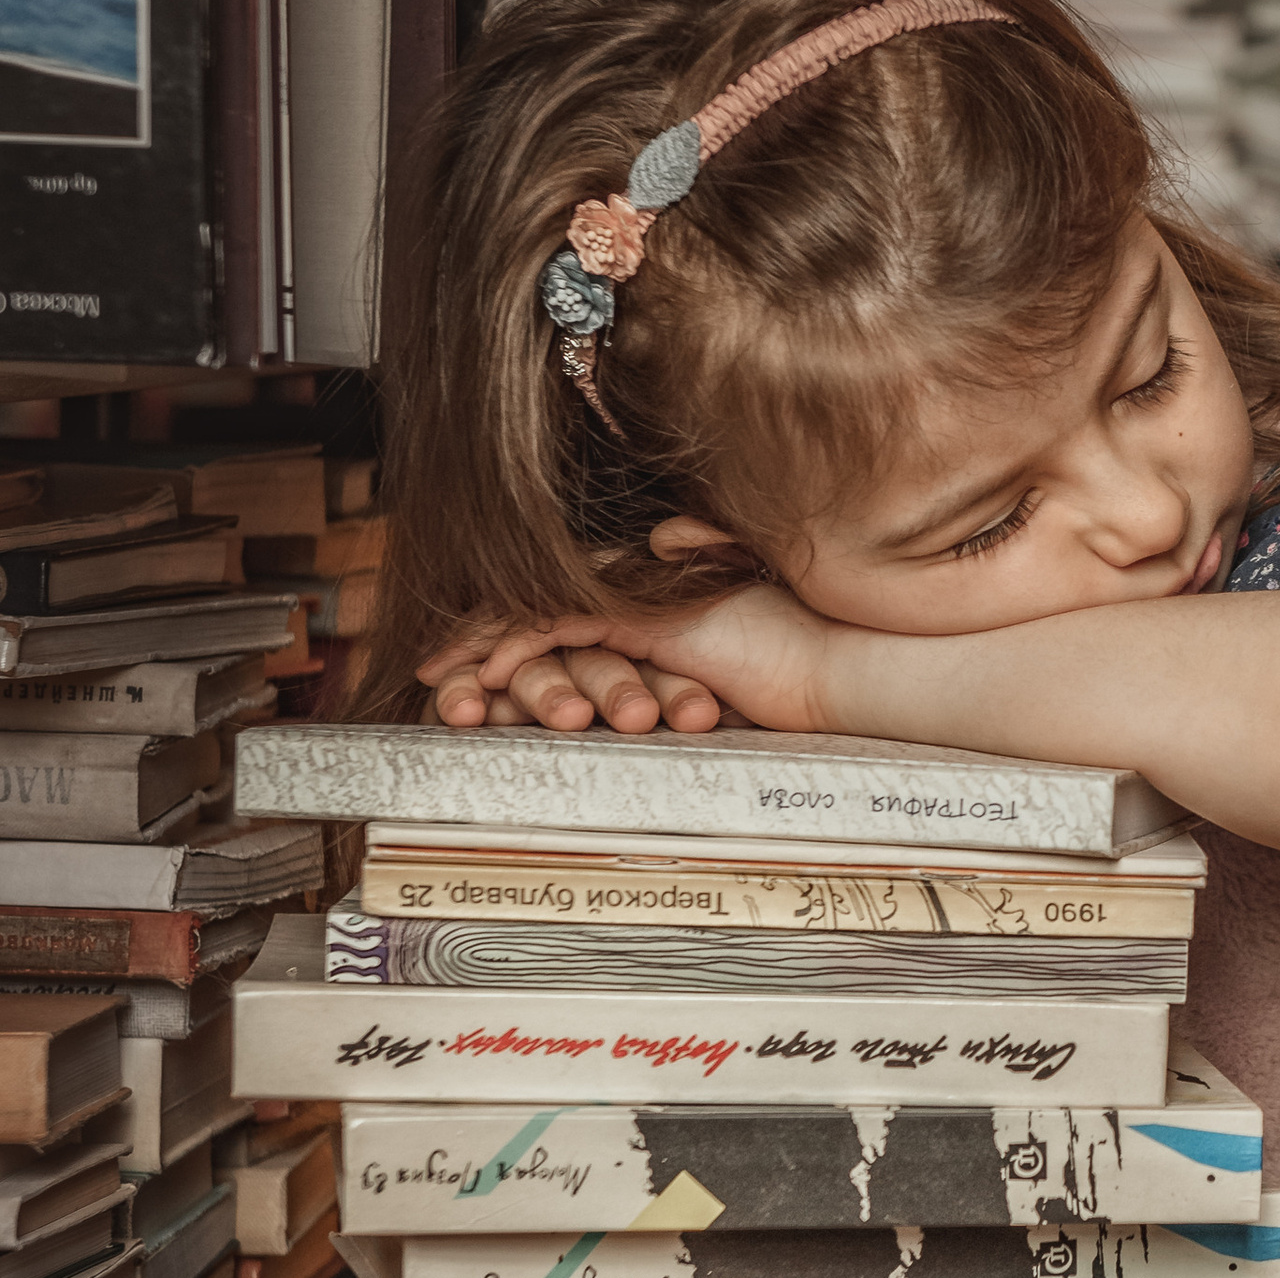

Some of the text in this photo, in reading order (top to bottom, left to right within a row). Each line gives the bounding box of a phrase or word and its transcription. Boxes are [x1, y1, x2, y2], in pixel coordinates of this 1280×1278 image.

[398, 880, 1109, 926] 1990 Тверской бульвар, 25
[848, 1034, 949, 1072] этого
[957, 1032, 1078, 1082] Стихи
